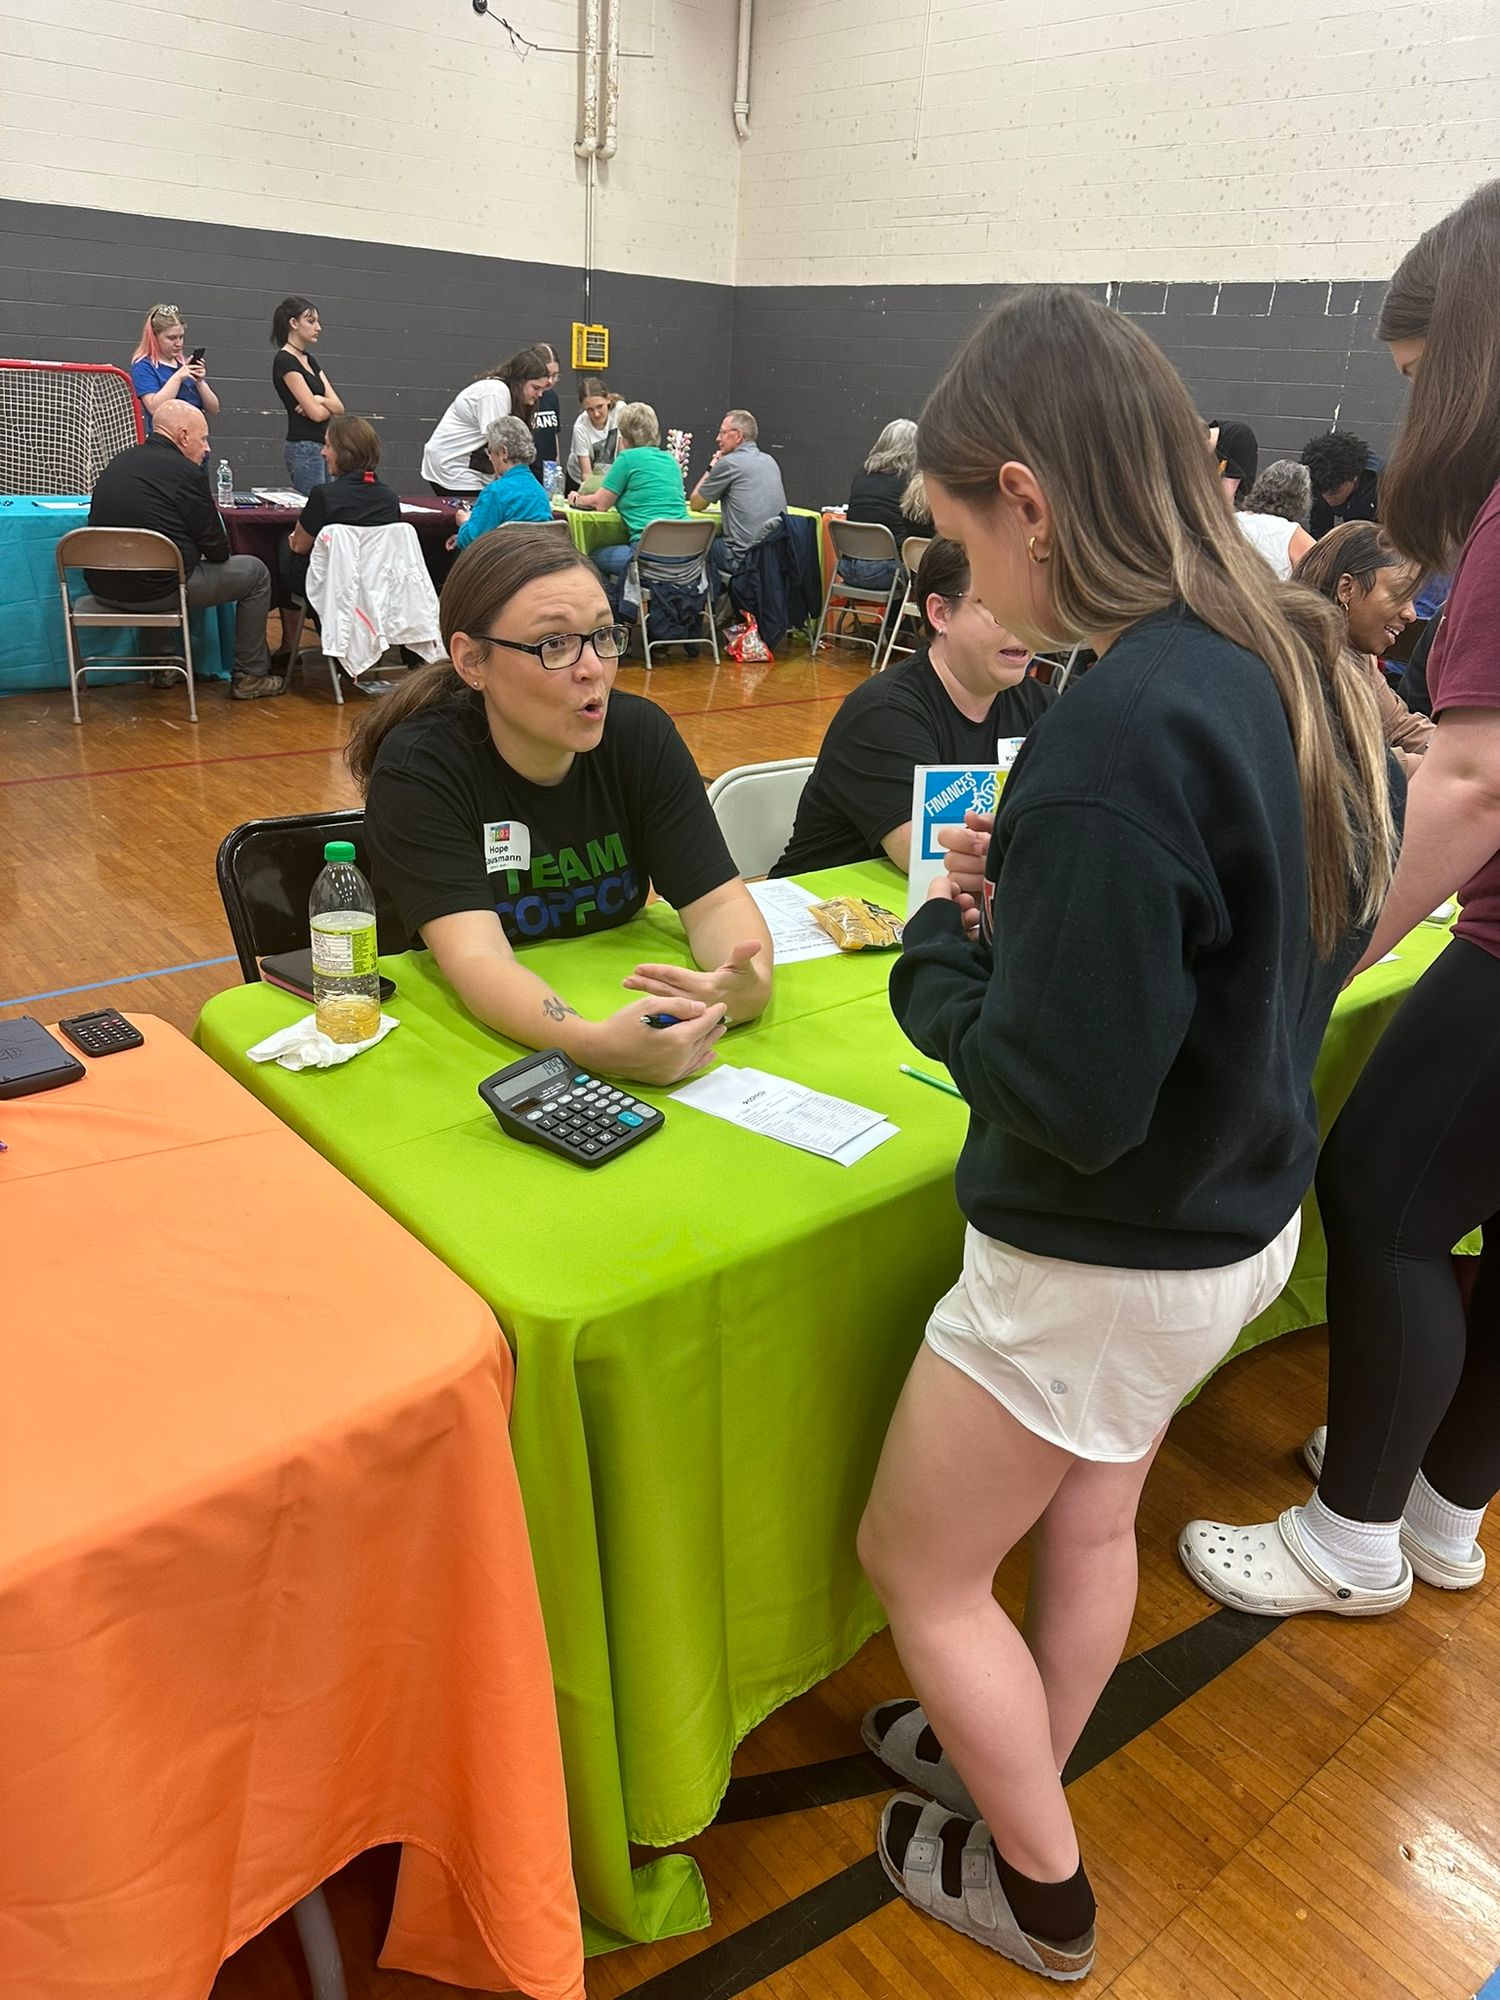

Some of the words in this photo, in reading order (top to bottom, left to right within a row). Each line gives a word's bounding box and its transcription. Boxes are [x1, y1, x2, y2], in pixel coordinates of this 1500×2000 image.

[532, 411, 558, 428] ANS
[925, 772, 977, 817] FINANCES
[489, 845, 509, 855] Hope
[505, 832, 629, 895] TEAM
